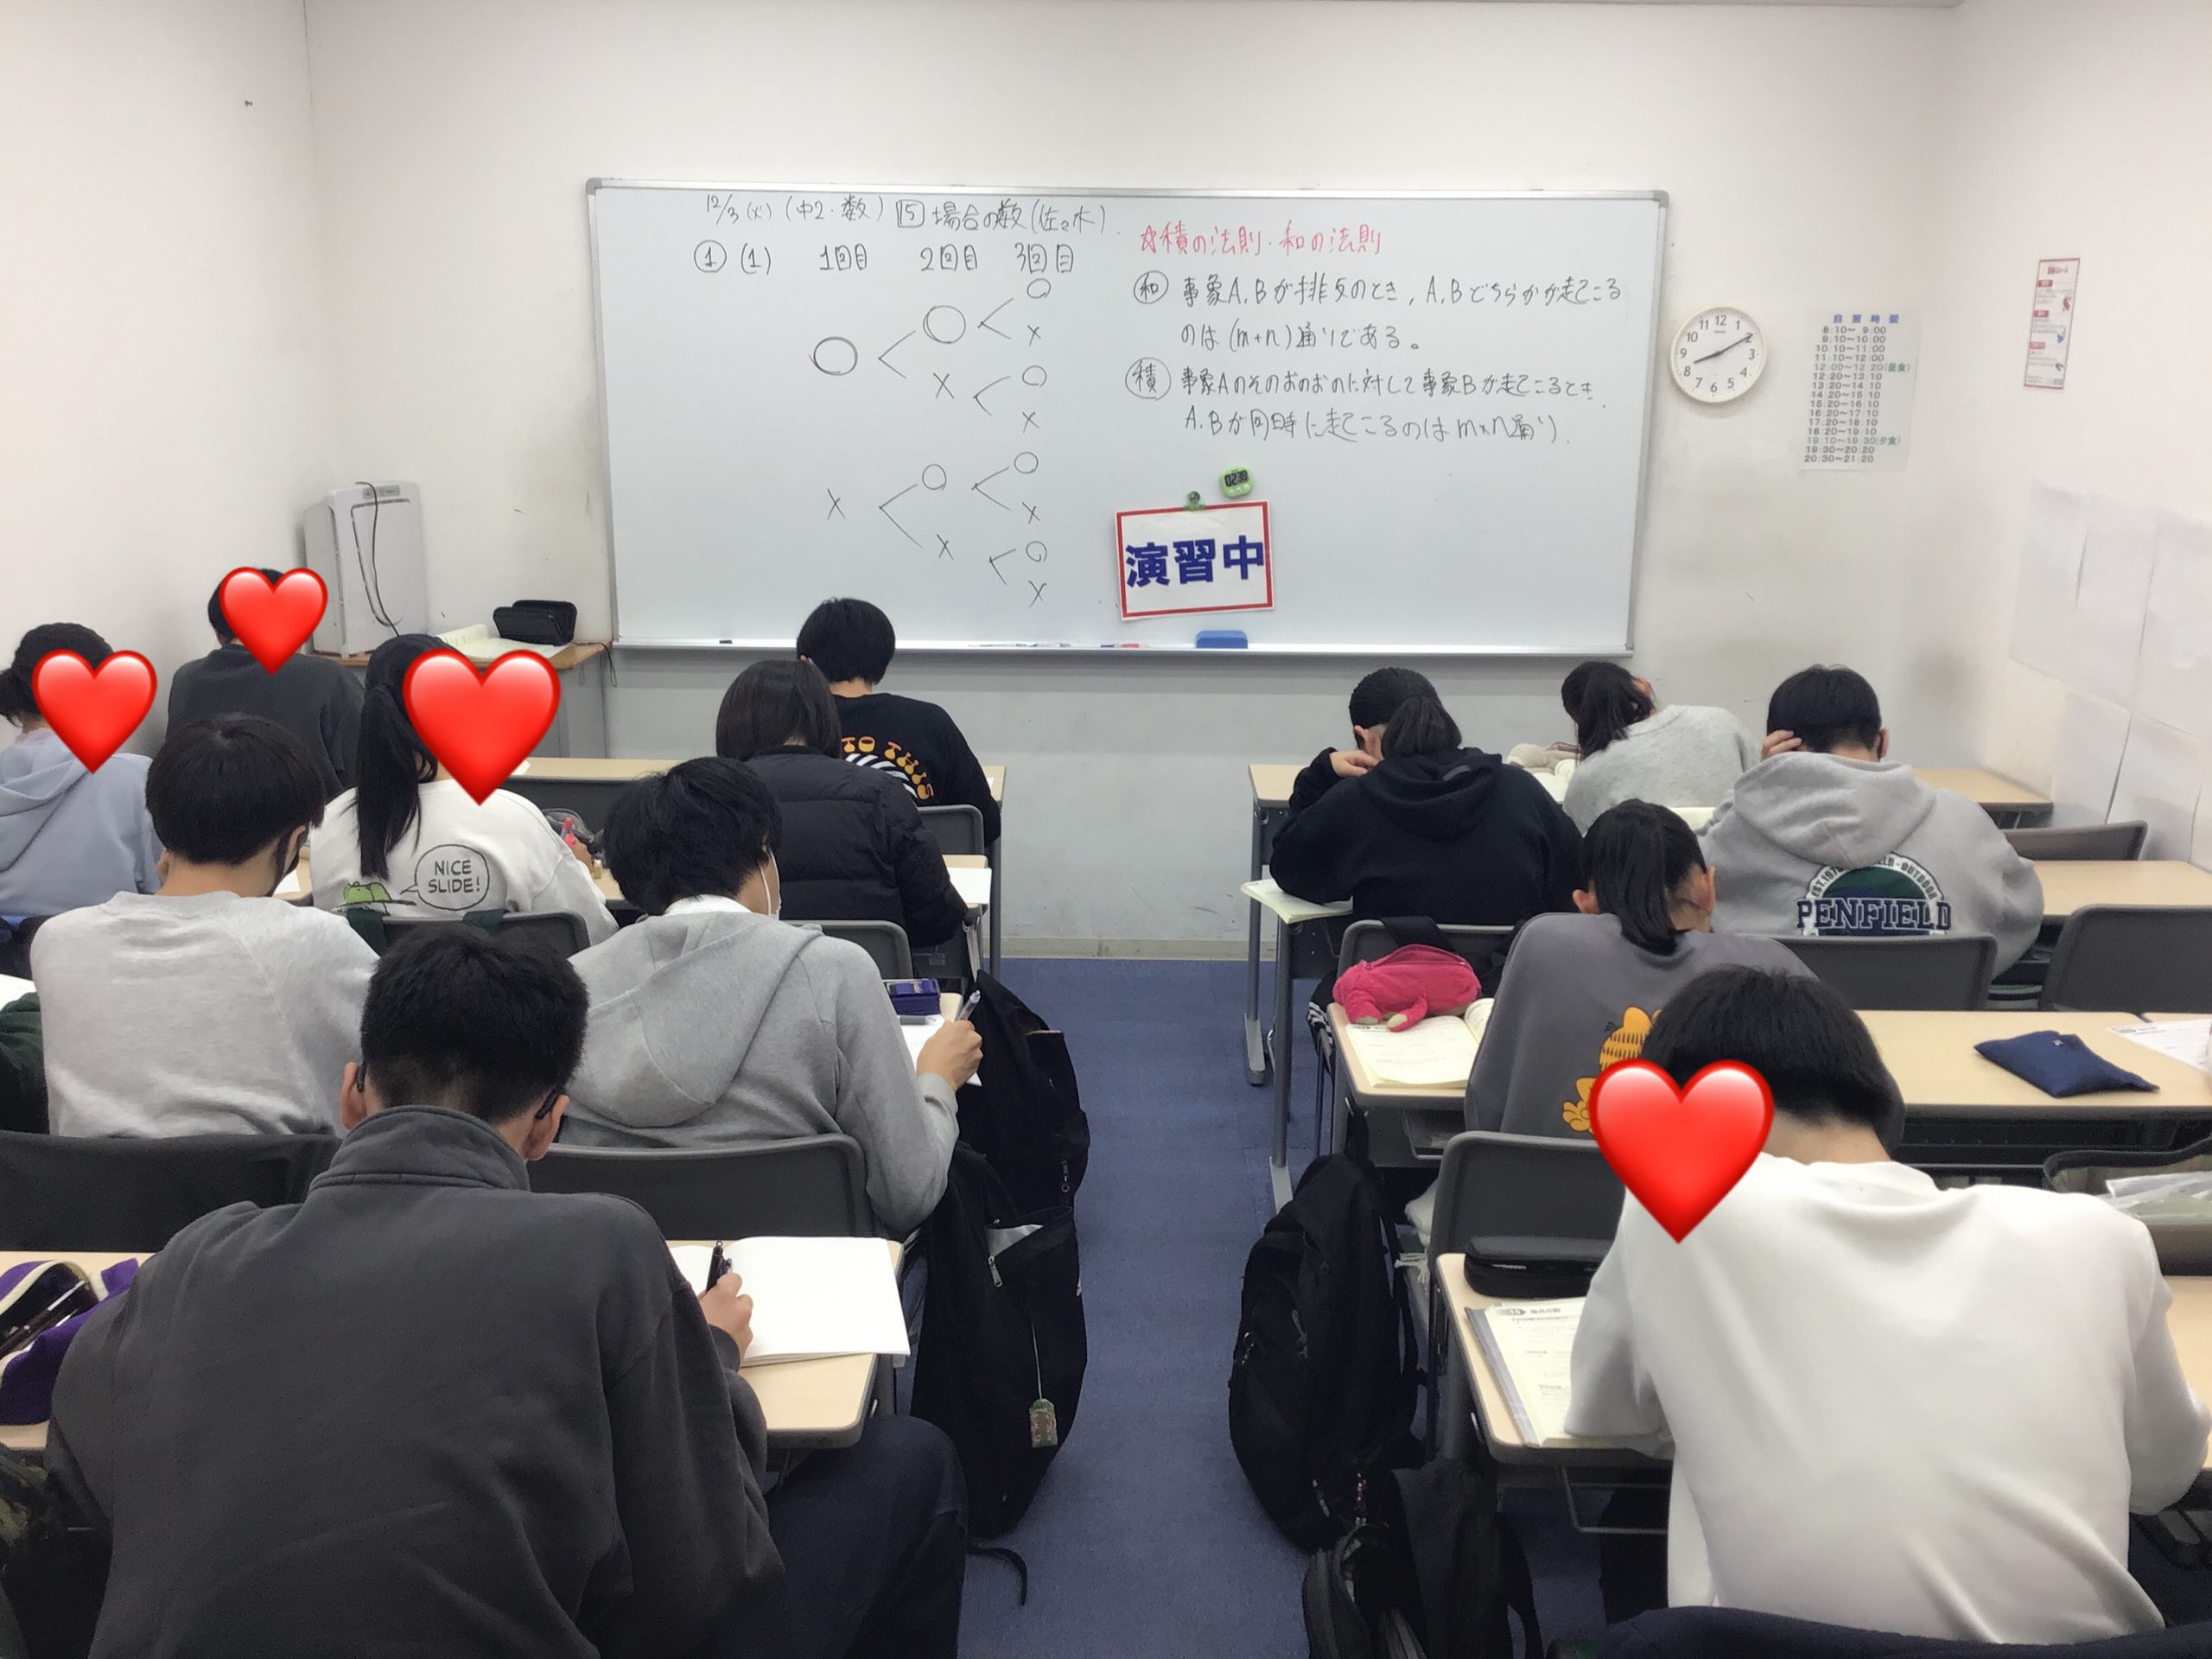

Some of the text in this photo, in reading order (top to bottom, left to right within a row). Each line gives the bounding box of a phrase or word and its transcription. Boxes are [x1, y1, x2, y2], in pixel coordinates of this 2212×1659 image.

[820, 244, 868, 271] 1回目
[920, 243, 978, 271] 2回目
[1699, 319, 1709, 330] 11
[1714, 315, 1726, 326] 12
[1735, 320, 1740, 330] 1
[1687, 331, 1699, 342] 10
[1680, 347, 1687, 359] 9
[1749, 349, 1756, 359] 3
[1683, 365, 1690, 377] 8
[1740, 366, 1748, 377] 4
[1695, 377, 1703, 388] 7
[1711, 382, 1718, 392] 6
[1728, 378, 1735, 389] 5
[1125, 534, 1264, 588] 演習中
[435, 860, 472, 876] NICE
[429, 876, 480, 893] SLIDE!
[1796, 897, 1952, 931] PENFIELD
